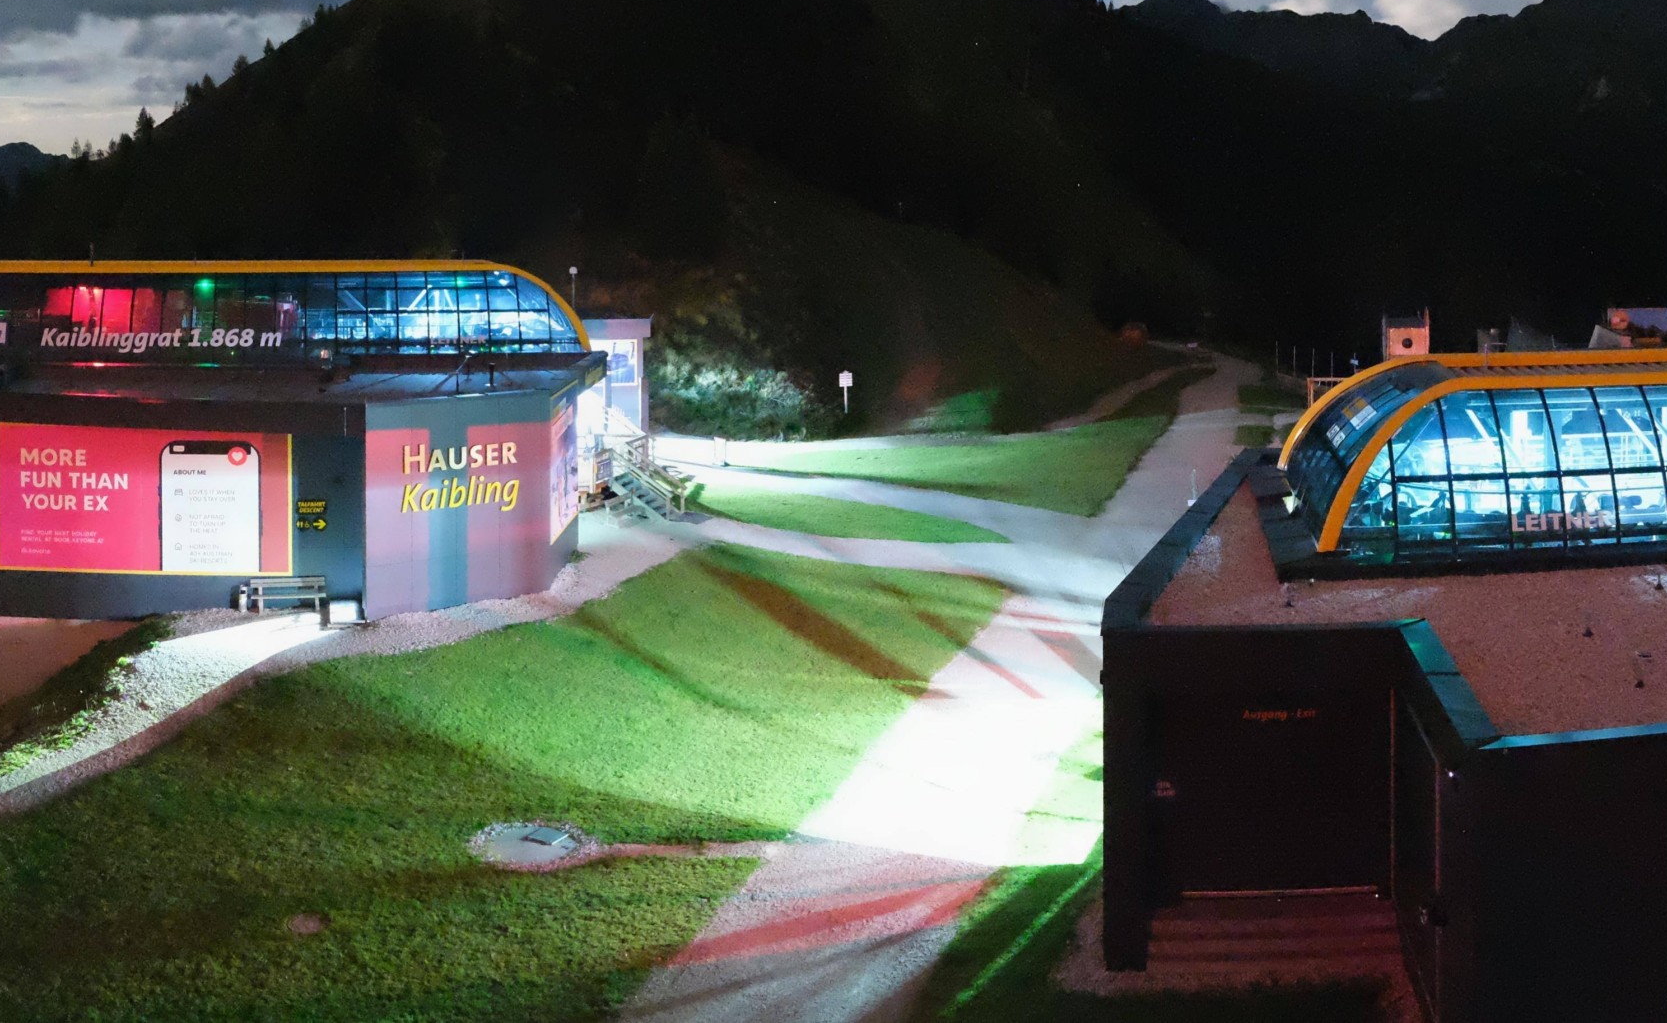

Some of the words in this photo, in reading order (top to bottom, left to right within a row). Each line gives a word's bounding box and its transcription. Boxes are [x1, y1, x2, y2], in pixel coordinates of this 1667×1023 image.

[40, 327, 181, 354] Kaiblinggrat
[188, 327, 254, 348] 1.868
[260, 332, 282, 348] m
[20, 447, 87, 467] MORE
[402, 441, 518, 475] HAUSER
[20, 471, 62, 488] FUN
[68, 472, 129, 490] THAN
[21, 493, 77, 511] YOUR
[83, 495, 109, 512] EX
[400, 475, 520, 514] Kaibling
[1511, 511, 1614, 533] LEITNER
